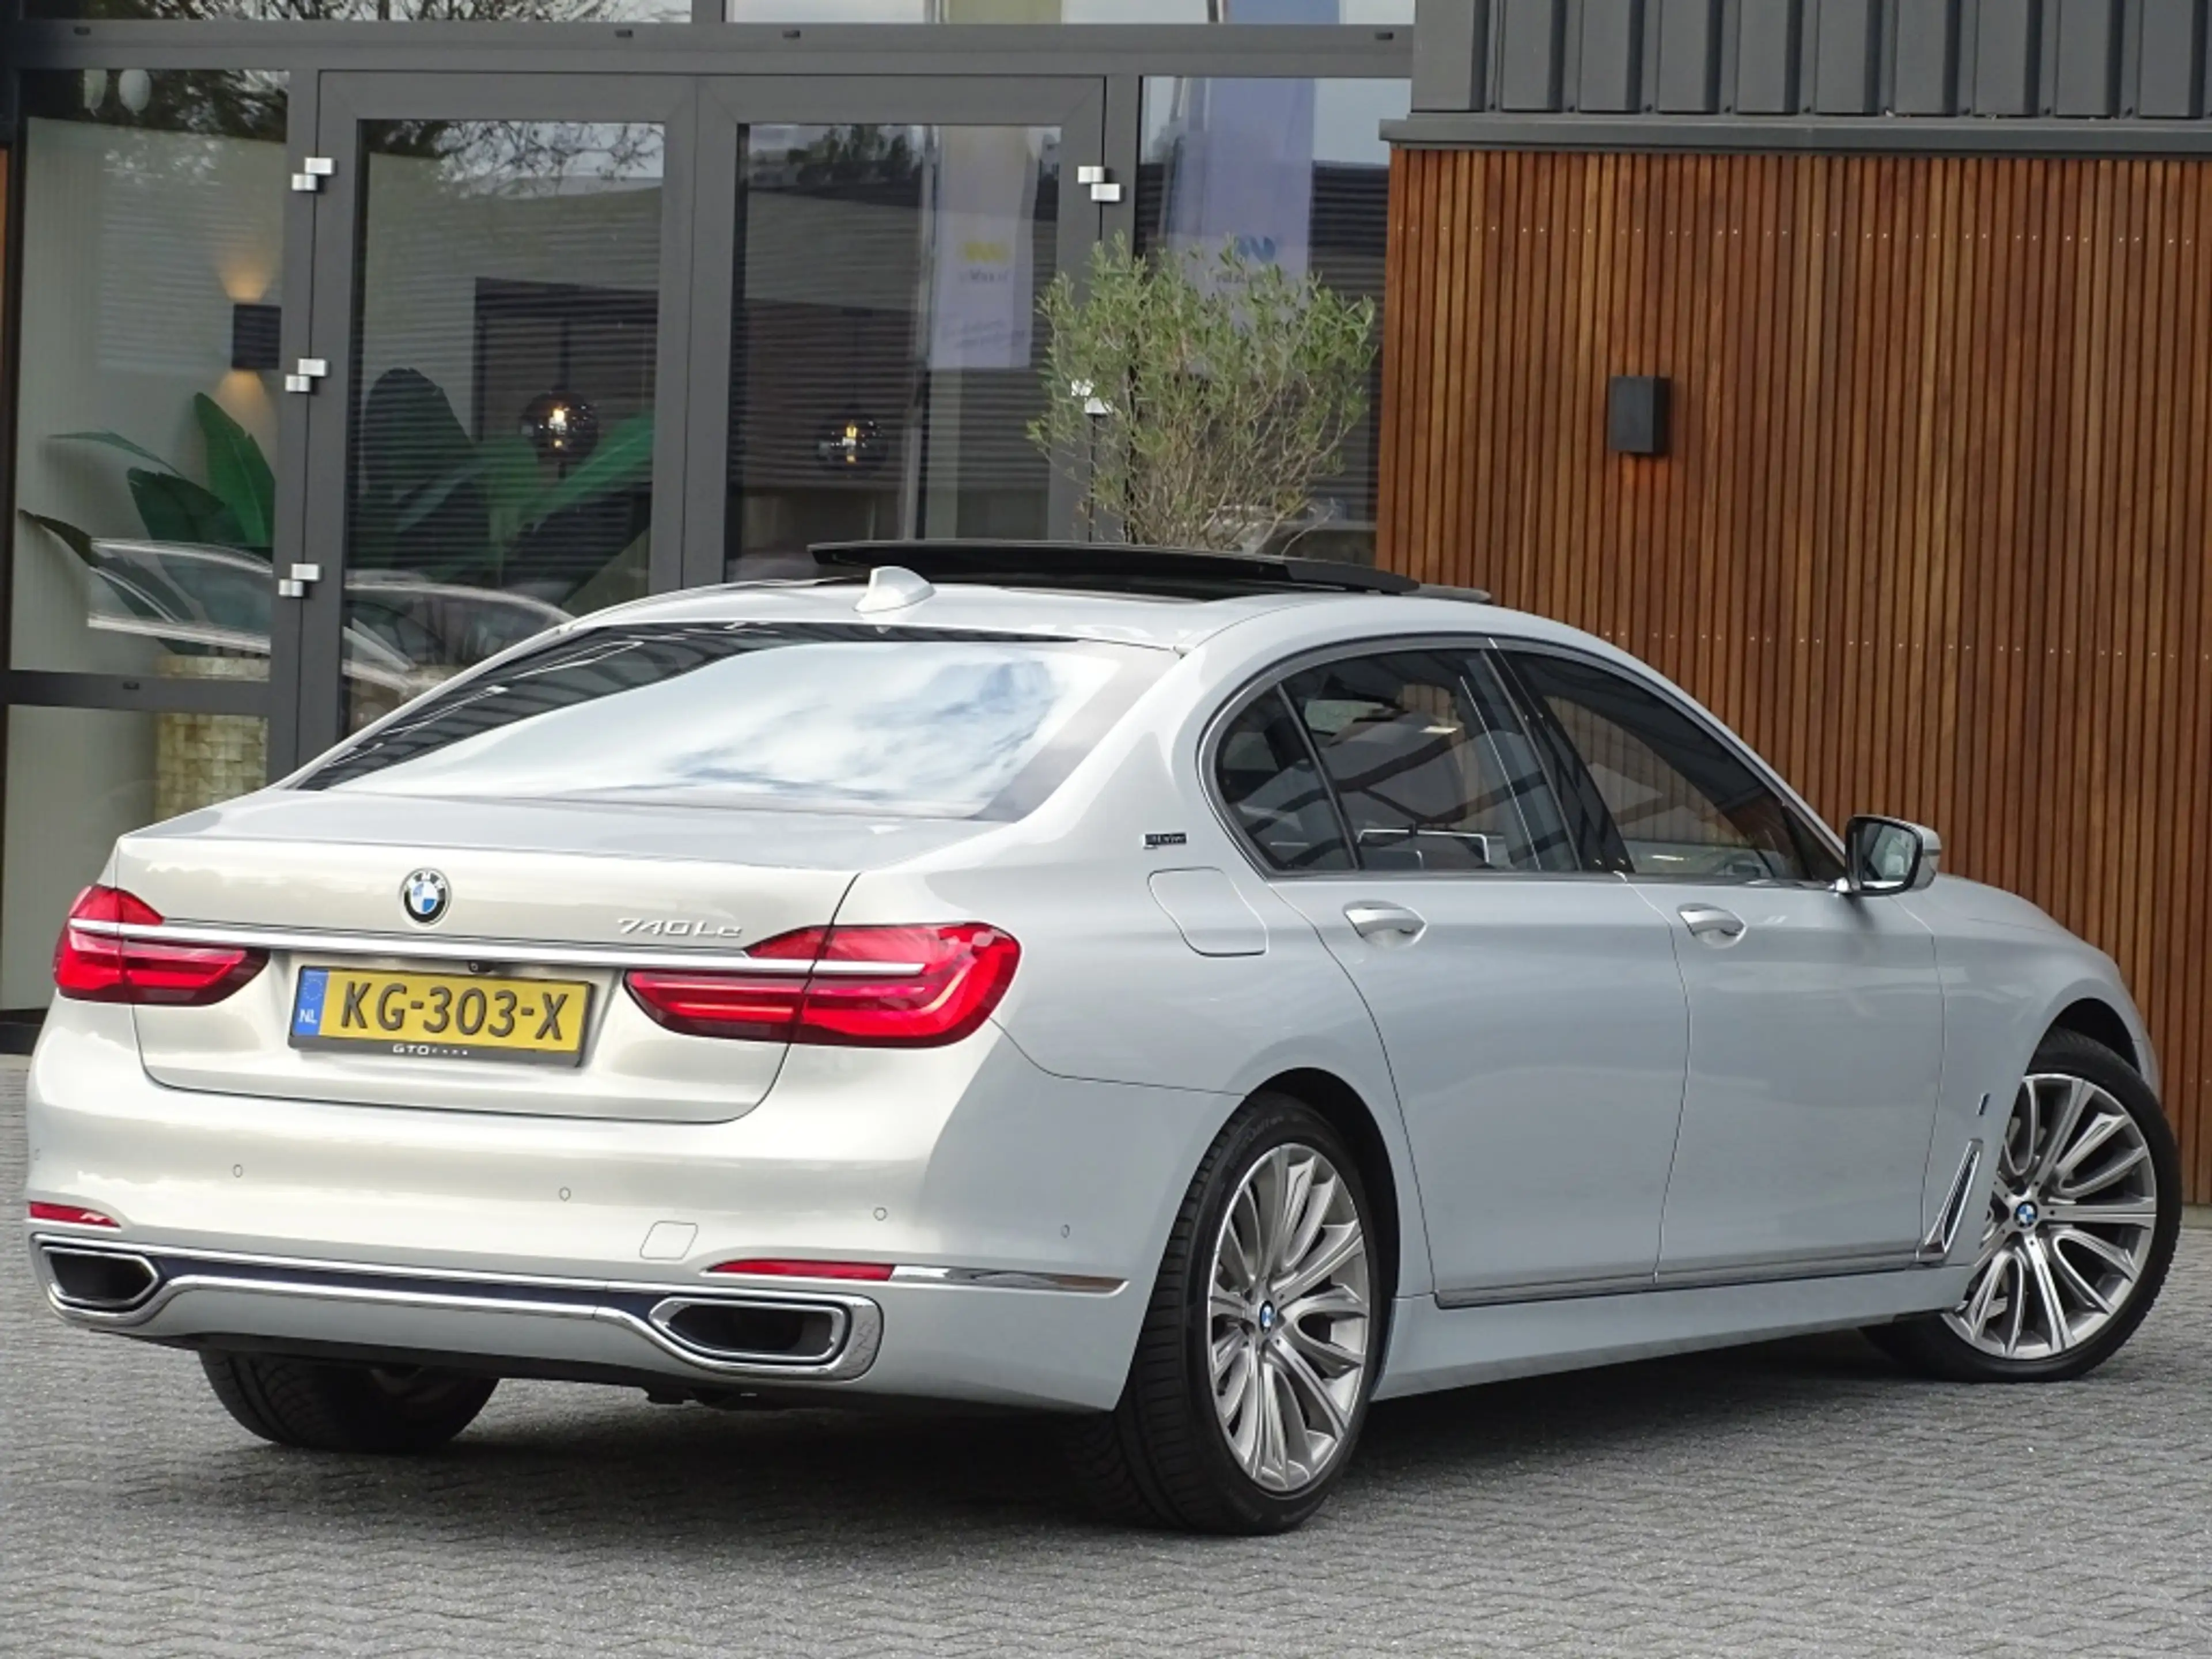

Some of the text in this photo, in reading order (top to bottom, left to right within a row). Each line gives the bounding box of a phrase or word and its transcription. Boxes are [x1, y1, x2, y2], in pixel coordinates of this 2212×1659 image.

[298, 1010, 317, 1024] NL
[341, 981, 568, 1040] KG-303-X
[393, 1044, 430, 1055] GTO
